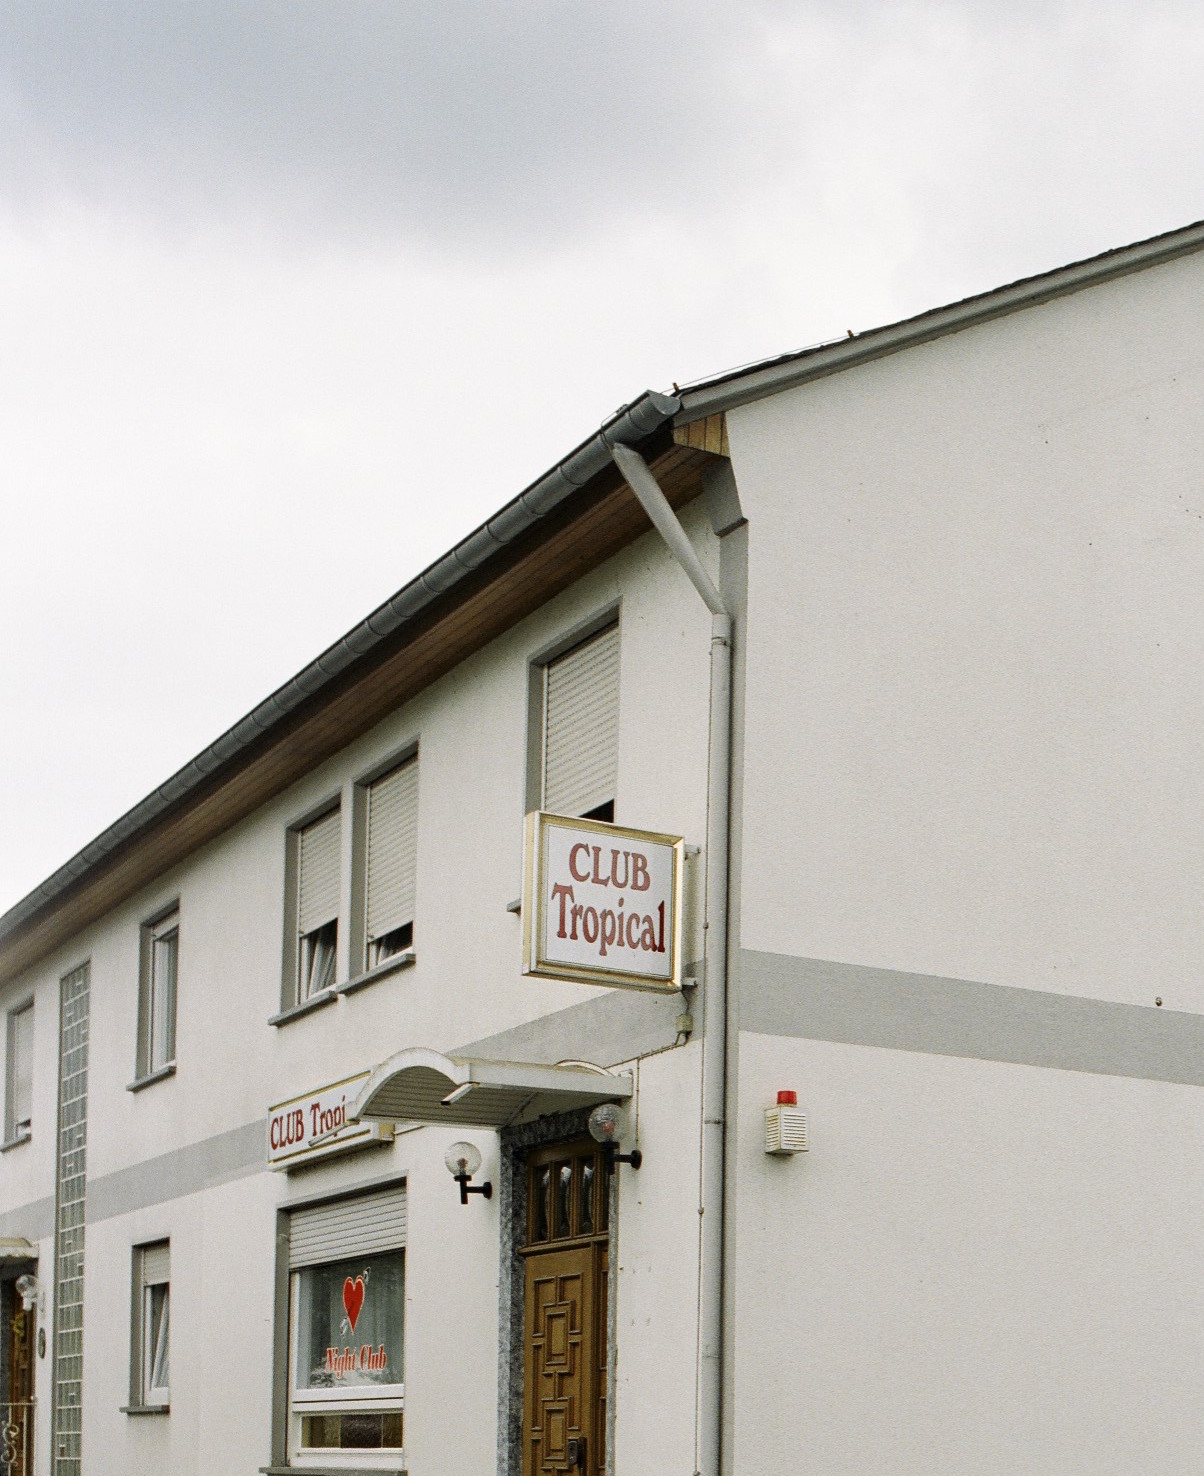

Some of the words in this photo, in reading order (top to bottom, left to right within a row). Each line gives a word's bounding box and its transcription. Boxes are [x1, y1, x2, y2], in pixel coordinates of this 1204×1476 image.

[569, 842, 650, 891] CLUB
[551, 882, 666, 956] Tropical
[270, 1108, 304, 1150] CLUB
[310, 1095, 346, 1137] Tropi
[324, 1346, 356, 1379] Night
[360, 1343, 387, 1370] Club
